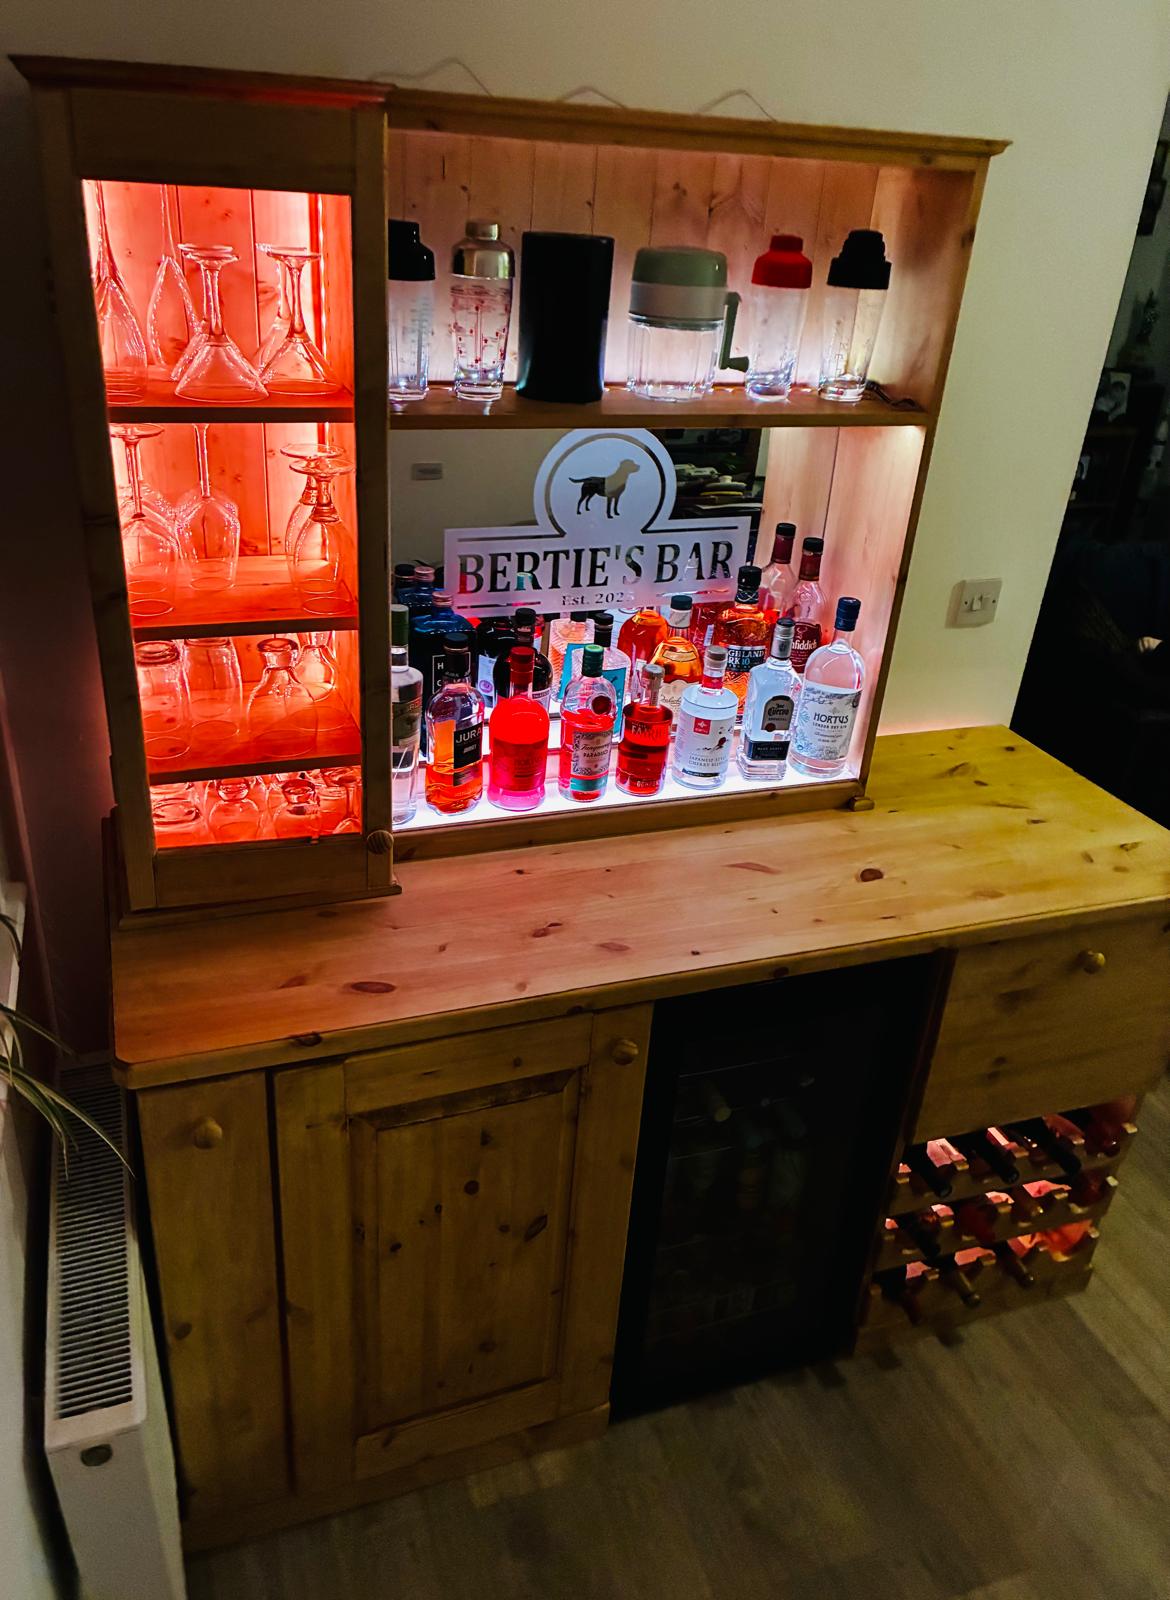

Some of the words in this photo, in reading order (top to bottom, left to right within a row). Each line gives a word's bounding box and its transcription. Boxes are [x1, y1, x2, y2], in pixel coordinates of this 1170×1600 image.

[458, 544, 645, 594] BERTIE'S
[654, 540, 734, 583] BAR
[561, 593, 590, 606] Est.
[791, 640, 818, 650] nfiddich
[728, 649, 764, 657] GHLAND
[728, 656, 740, 665] RK
[813, 712, 849, 724] HORTUS
[455, 727, 482, 744] JURA
